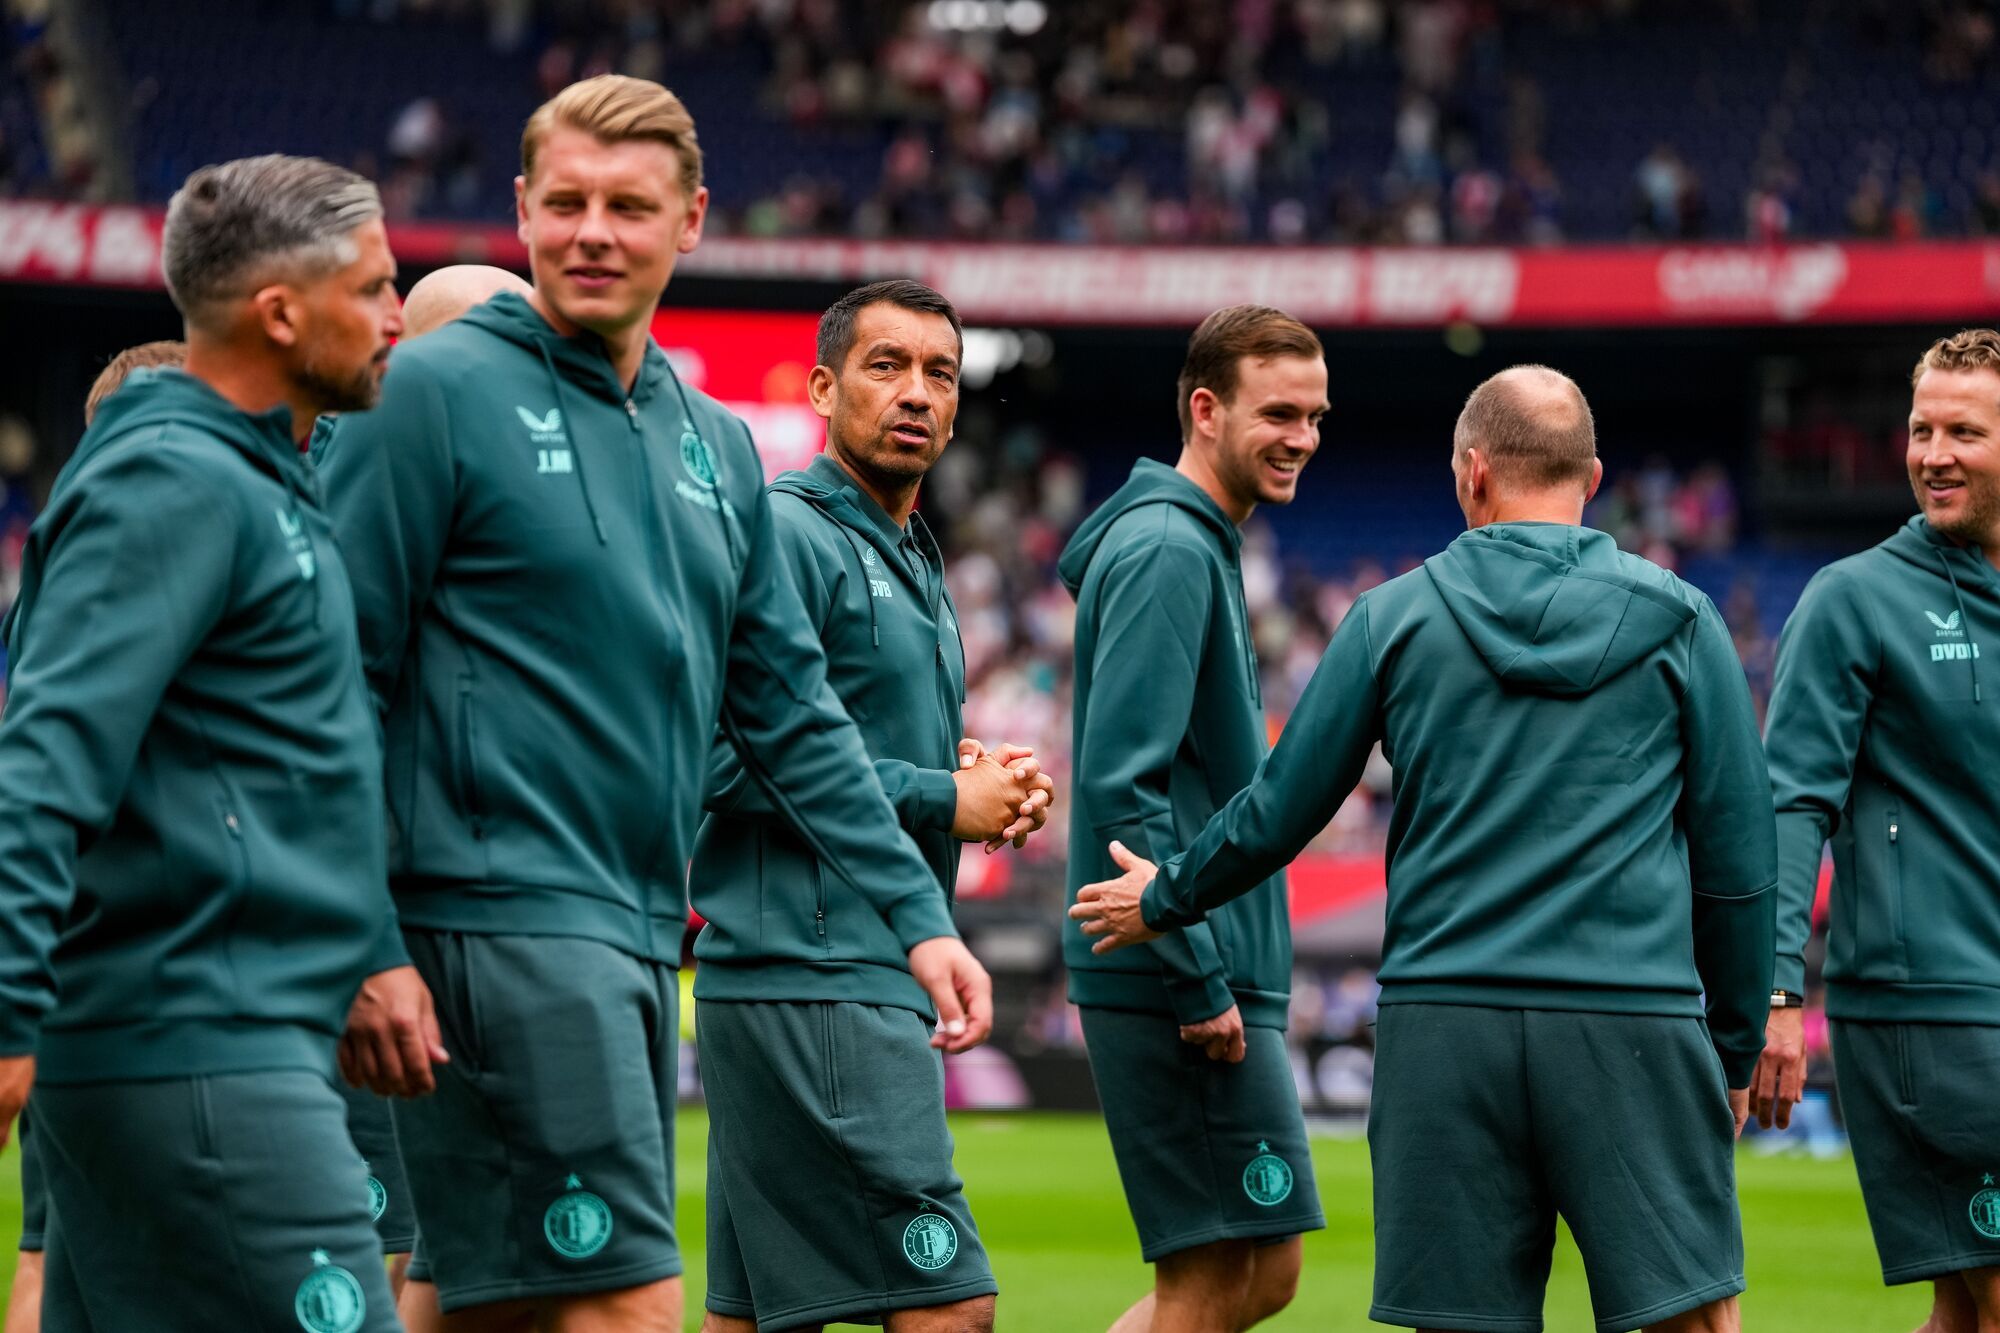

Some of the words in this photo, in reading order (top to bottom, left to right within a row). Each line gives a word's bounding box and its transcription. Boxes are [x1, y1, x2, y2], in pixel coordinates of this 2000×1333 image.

[907, 1216, 951, 1238] FEYENOORD
[919, 1227, 941, 1257] F
[911, 1246, 955, 1268] ROTTERDAM
